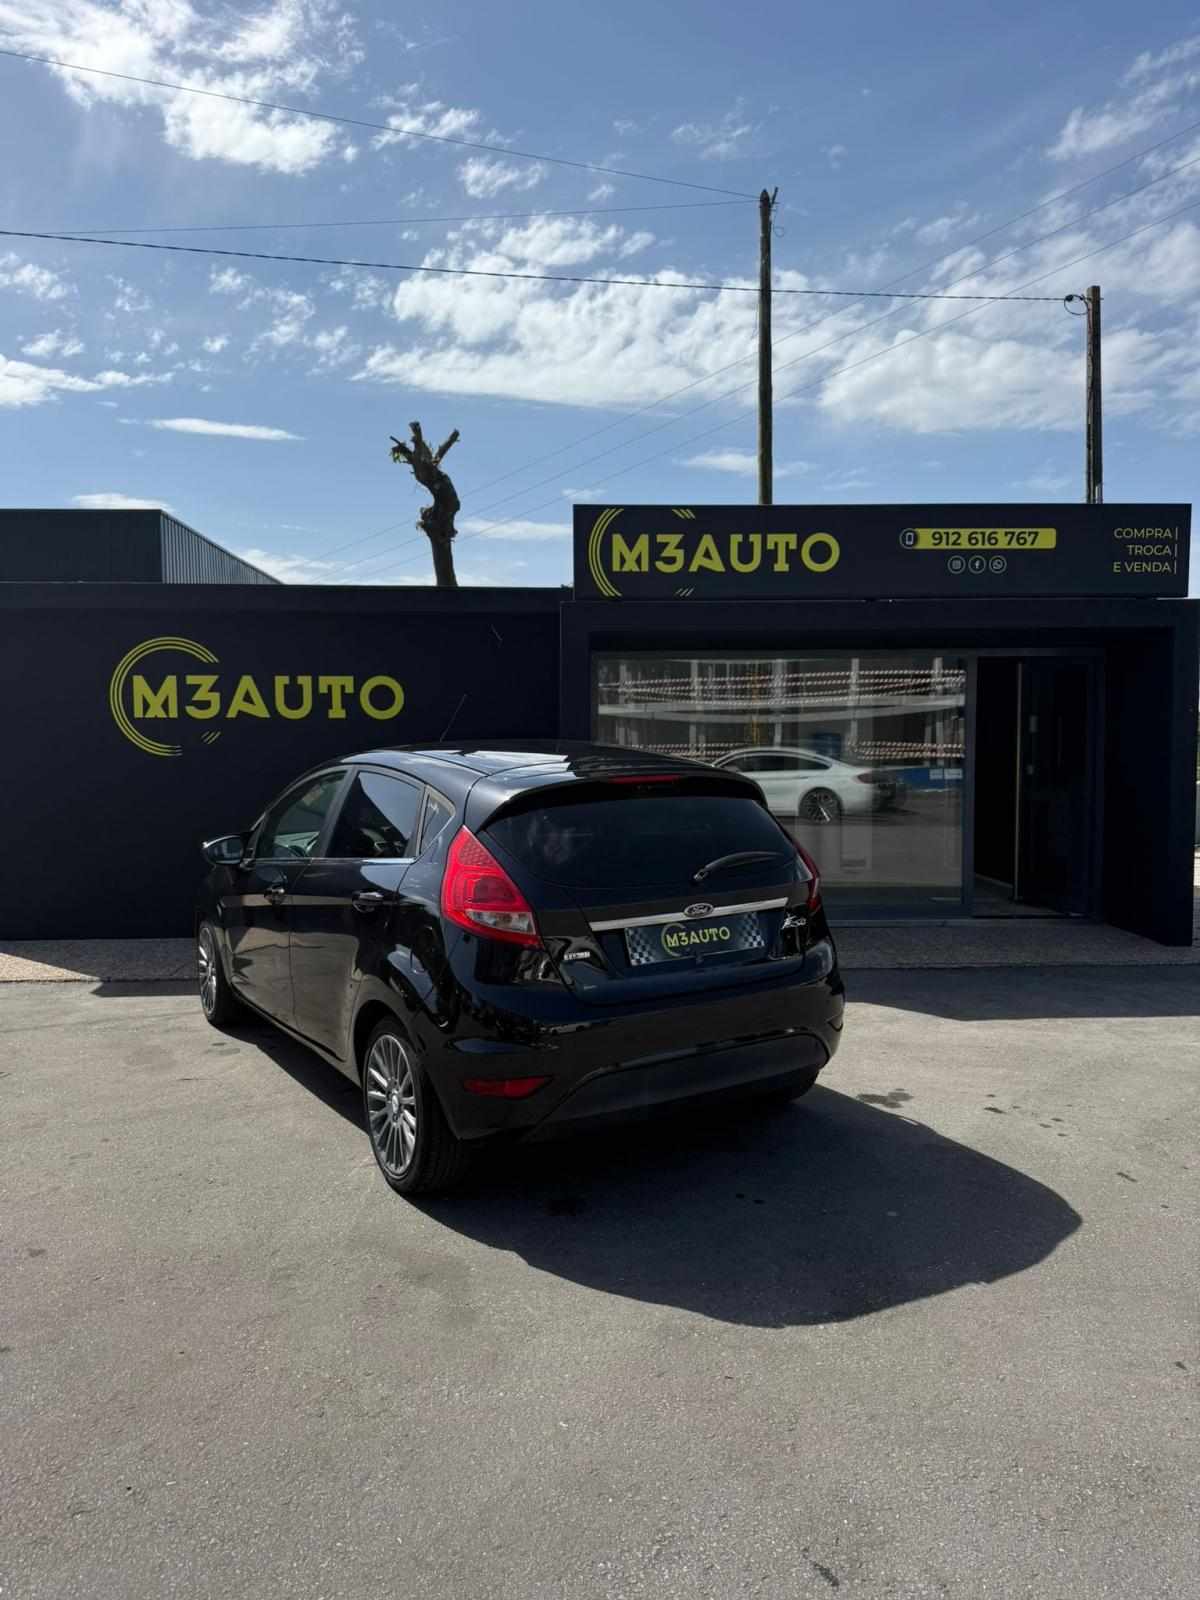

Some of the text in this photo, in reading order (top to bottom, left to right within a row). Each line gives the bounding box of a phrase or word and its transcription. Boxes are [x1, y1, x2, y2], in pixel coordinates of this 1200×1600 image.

[931, 531, 1039, 546] 912 616 767
[1113, 527, 1173, 539] COMPRA
[611, 532, 840, 573] M3AUTO
[1127, 544, 1172, 556] TROCA
[1113, 561, 1172, 573] E VENDA
[132, 674, 405, 720] M3AUTO
[665, 926, 731, 947] M3AUTO
